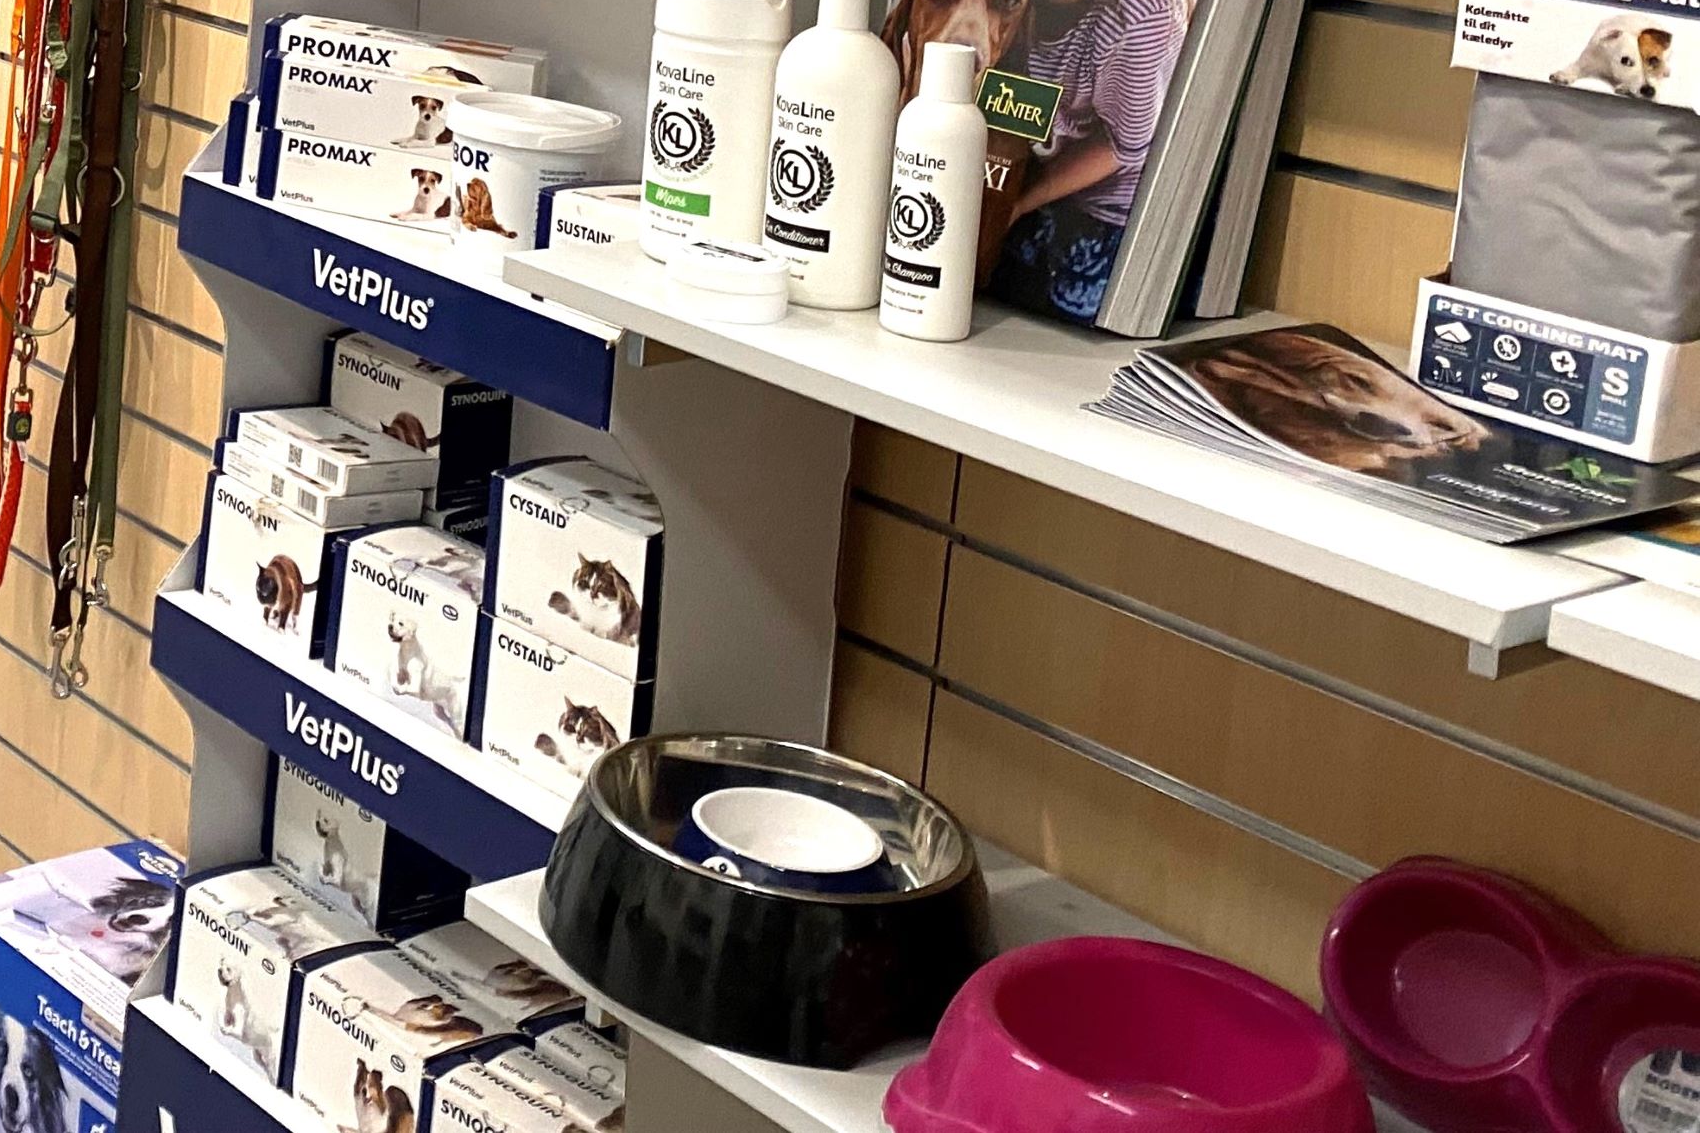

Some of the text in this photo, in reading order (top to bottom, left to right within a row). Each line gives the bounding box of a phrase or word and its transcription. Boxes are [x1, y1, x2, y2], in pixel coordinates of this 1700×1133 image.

[1464, 18, 1496, 32] til dit
[1465, 3, 1529, 24] Kølemåtte
[287, 34, 392, 67] PROMAX
[1461, 31, 1513, 50] kæledyr
[288, 66, 373, 95] PROMAX
[656, 60, 715, 87] KovaLine
[659, 81, 704, 101] Skin Care
[776, 94, 835, 121] KovaLine
[985, 93, 1042, 126] HUNTER
[662, 118, 689, 152] KL
[778, 116, 822, 137] Skin Care
[287, 138, 373, 167] PROMAX
[779, 157, 808, 191] KL
[911, 170, 933, 183] Care
[655, 186, 687, 207] Wipes
[556, 219, 612, 244] SUSTAIN
[896, 201, 921, 231] KL
[773, 224, 825, 246] Conditioner
[892, 261, 934, 282] Shampoo
[313, 248, 429, 330] VetPlus
[1435, 299, 1643, 363] PET COOLING MAT
[338, 354, 401, 391] SYNOQUIN
[1602, 366, 1630, 397] S
[509, 494, 567, 530] CYSTAID
[351, 559, 426, 607] SYNOQUIN
[501, 603, 533, 626] VetPlus
[498, 633, 554, 672] CYSTAID
[285, 692, 400, 796] VetPlus
[489, 742, 520, 766] VetPlus
[283, 760, 345, 807] SYNOQUIN
[188, 902, 248, 957] SYNOQUIN
[37, 994, 77, 1043] Teach
[78, 1030, 90, 1052] &
[89, 1033, 121, 1076] Trea
[308, 991, 375, 1052] SYNOQUIN
[520, 1050, 612, 1101] SYNOQUIN
[471, 1066, 563, 1118] SYNOQUIN
